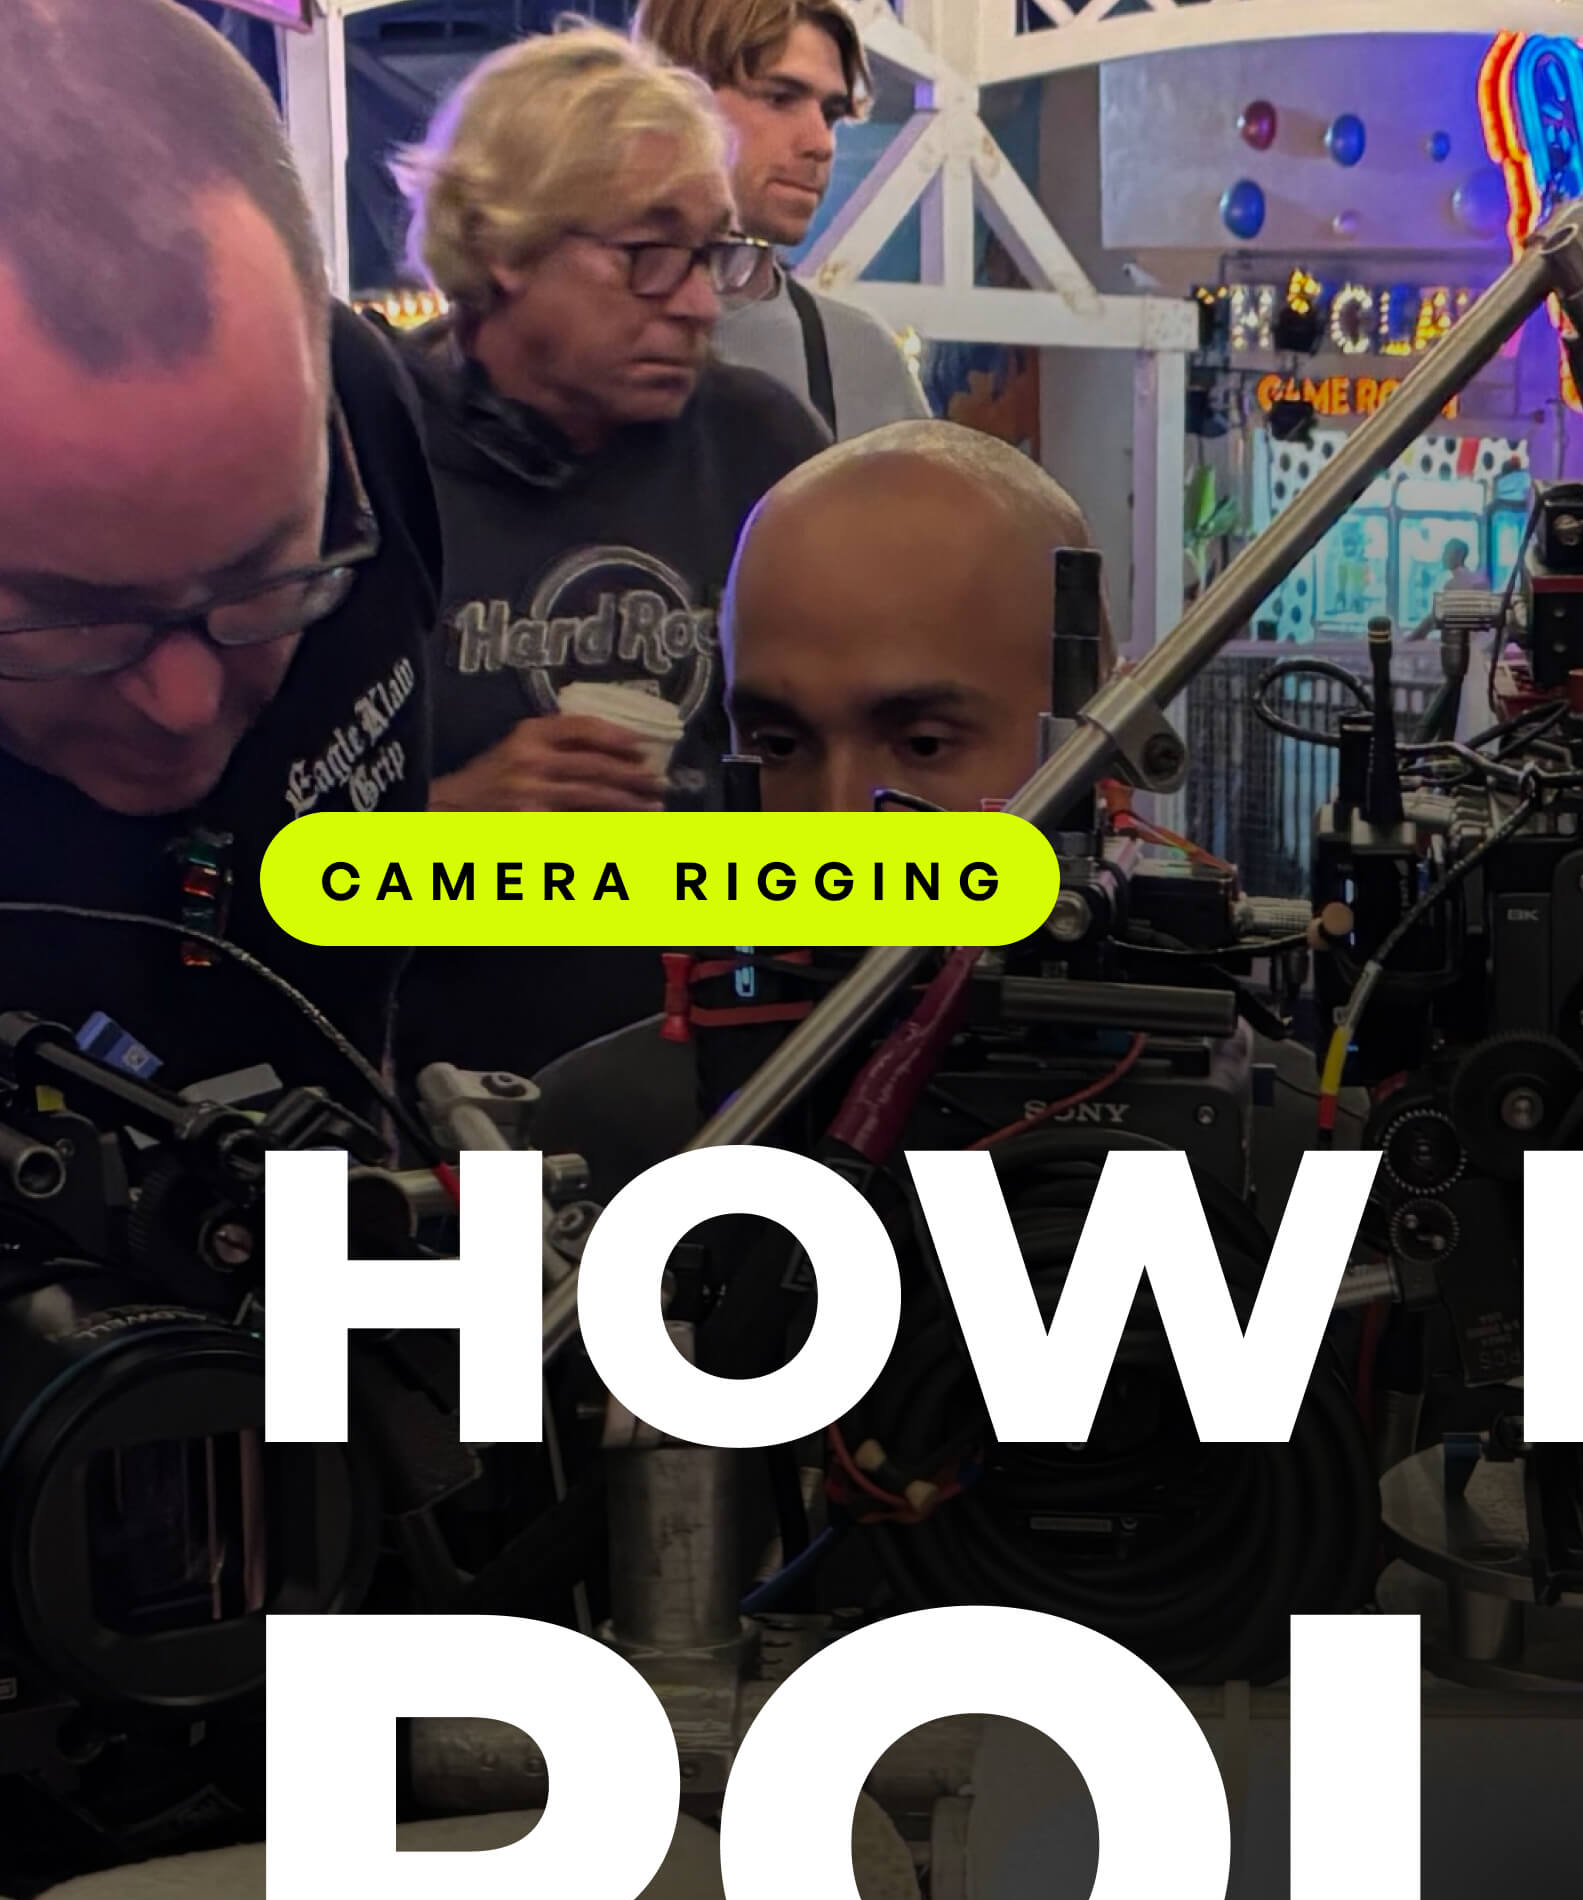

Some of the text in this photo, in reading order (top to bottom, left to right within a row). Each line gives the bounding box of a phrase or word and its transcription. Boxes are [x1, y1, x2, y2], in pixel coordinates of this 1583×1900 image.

[1330, 282, 1469, 356] CLA
[456, 589, 720, 675] Hard Roc
[285, 725, 366, 820] Eagle
[348, 740, 406, 813] Grip
[1022, 1097, 1131, 1124] SONY
